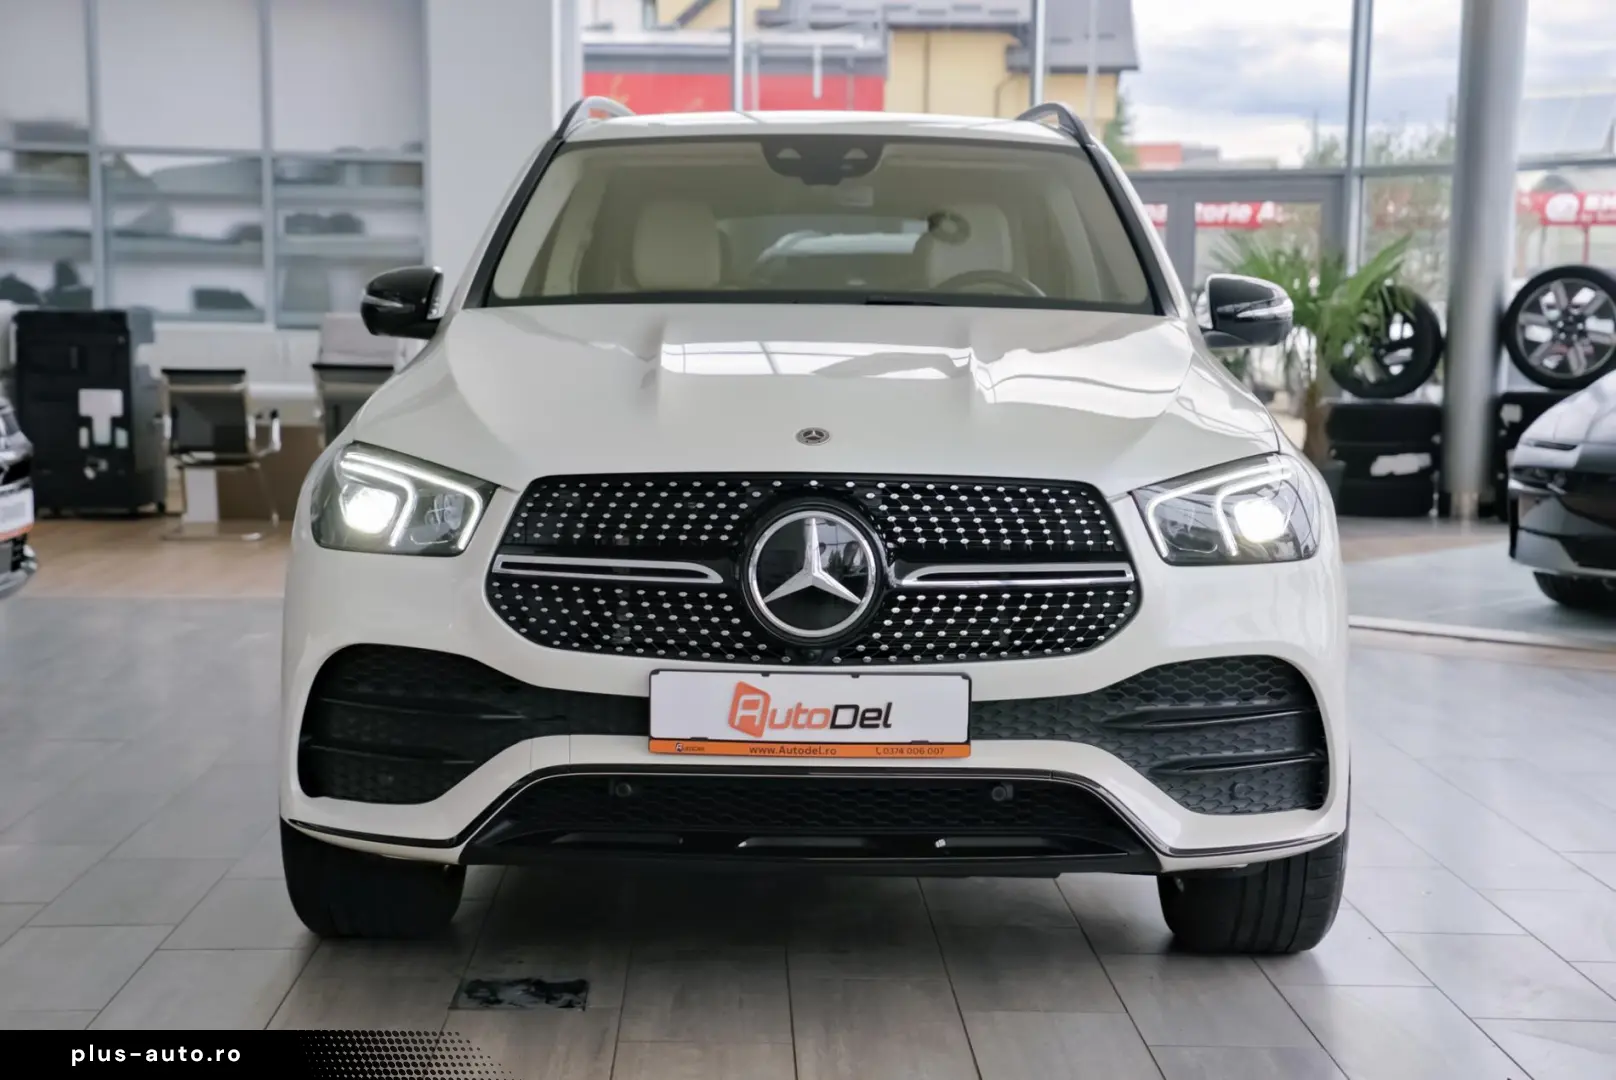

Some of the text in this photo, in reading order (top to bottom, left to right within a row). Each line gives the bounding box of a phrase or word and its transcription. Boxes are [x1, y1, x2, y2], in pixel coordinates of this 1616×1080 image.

[730, 686, 893, 733] AutoDel
[748, 745, 838, 756] www.Autodel.ro
[927, 746, 945, 756] 007
